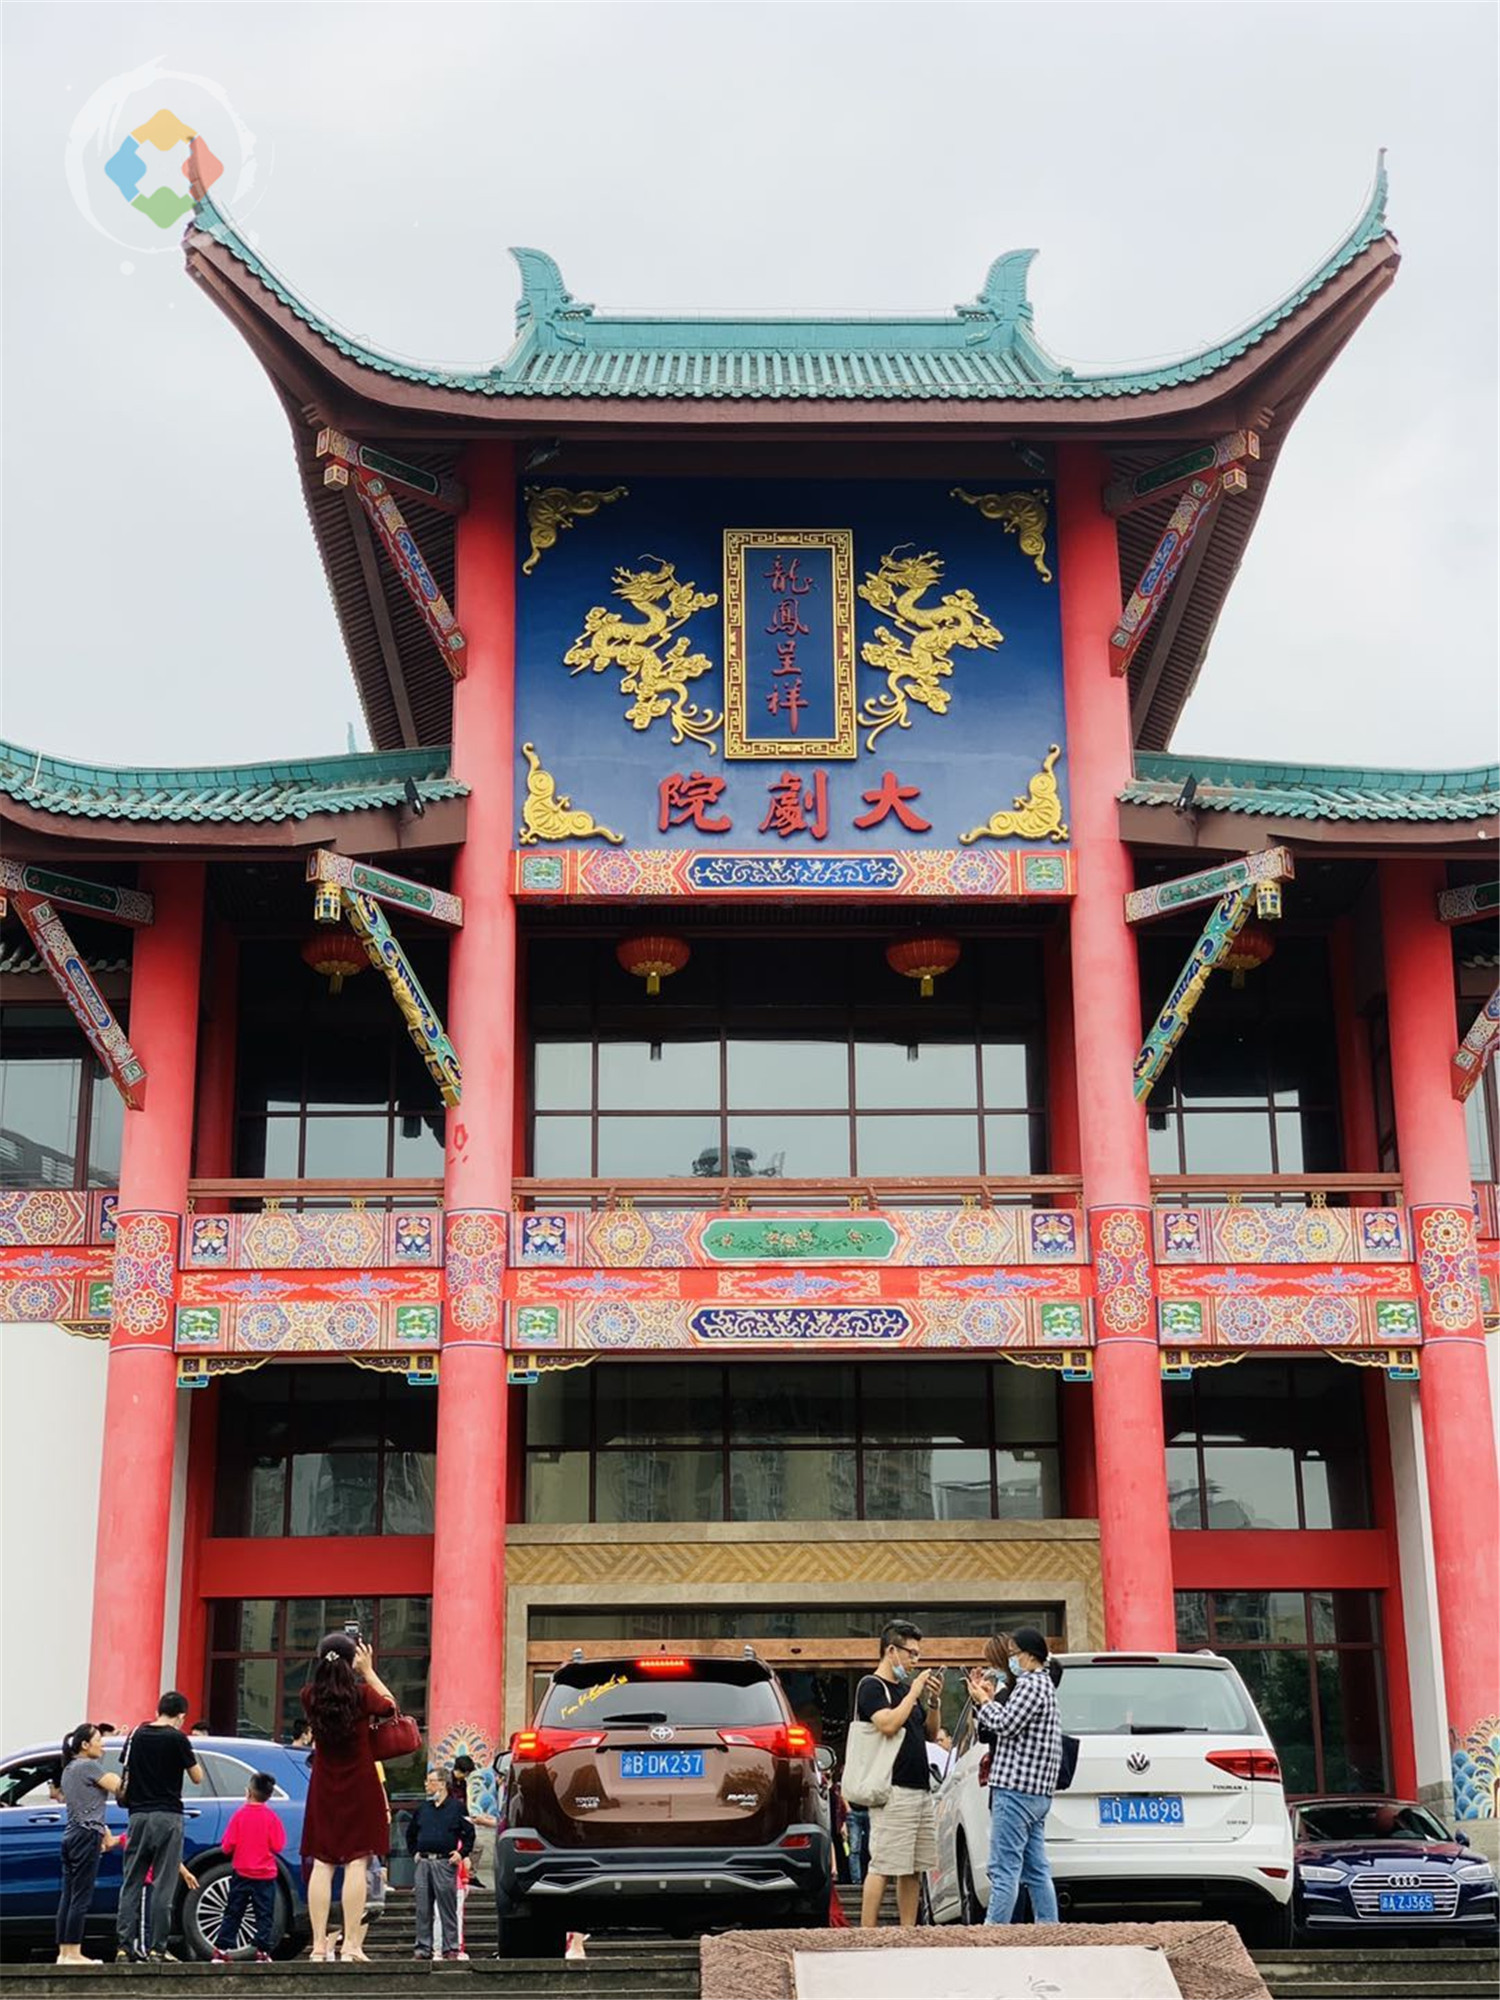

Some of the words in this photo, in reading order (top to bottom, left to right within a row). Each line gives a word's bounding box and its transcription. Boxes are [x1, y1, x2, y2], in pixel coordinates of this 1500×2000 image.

[763, 555, 814, 735] 龍鳳呈祥
[657, 768, 933, 840] 大劇院
